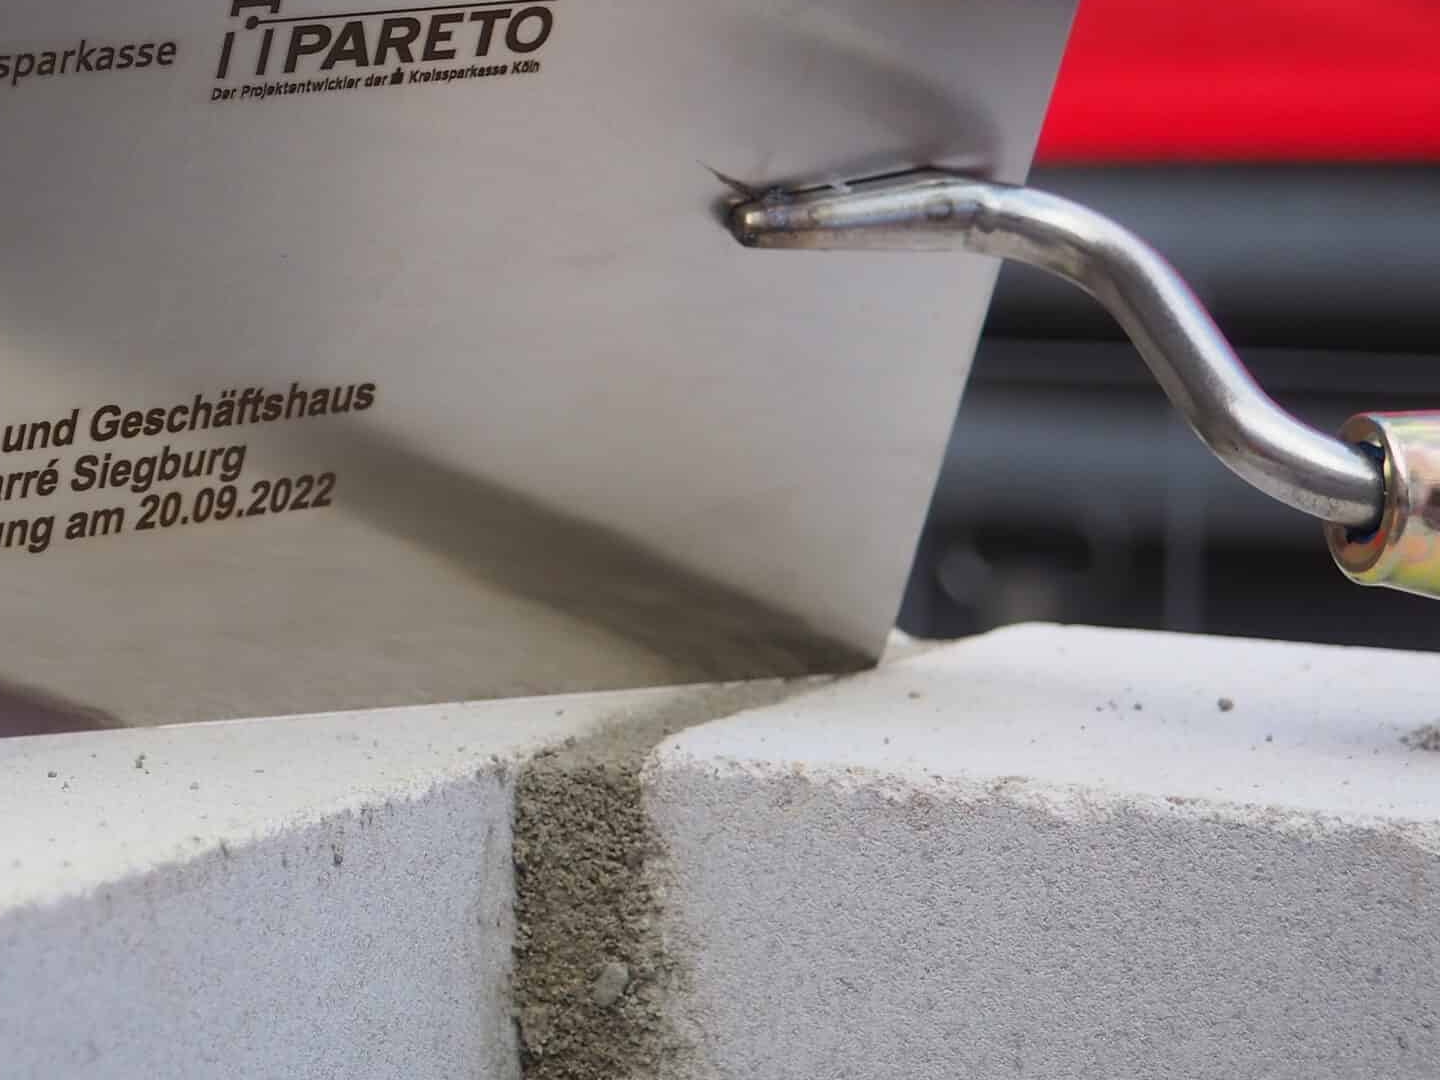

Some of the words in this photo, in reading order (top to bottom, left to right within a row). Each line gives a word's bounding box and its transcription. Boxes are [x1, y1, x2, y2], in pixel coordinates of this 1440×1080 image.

[283, 6, 553, 74] PARETO
[211, 85, 237, 101] Der
[240, 75, 362, 100] Projektentwickler
[364, 73, 388, 88] der
[409, 64, 508, 83] Kreissparkasse
[511, 59, 540, 75] Köln
[1, 410, 79, 452] und
[90, 381, 377, 442] Geschäftshaus
[70, 439, 247, 495] Siegburg
[65, 507, 125, 542] am
[135, 471, 337, 532] 20.09.2022
